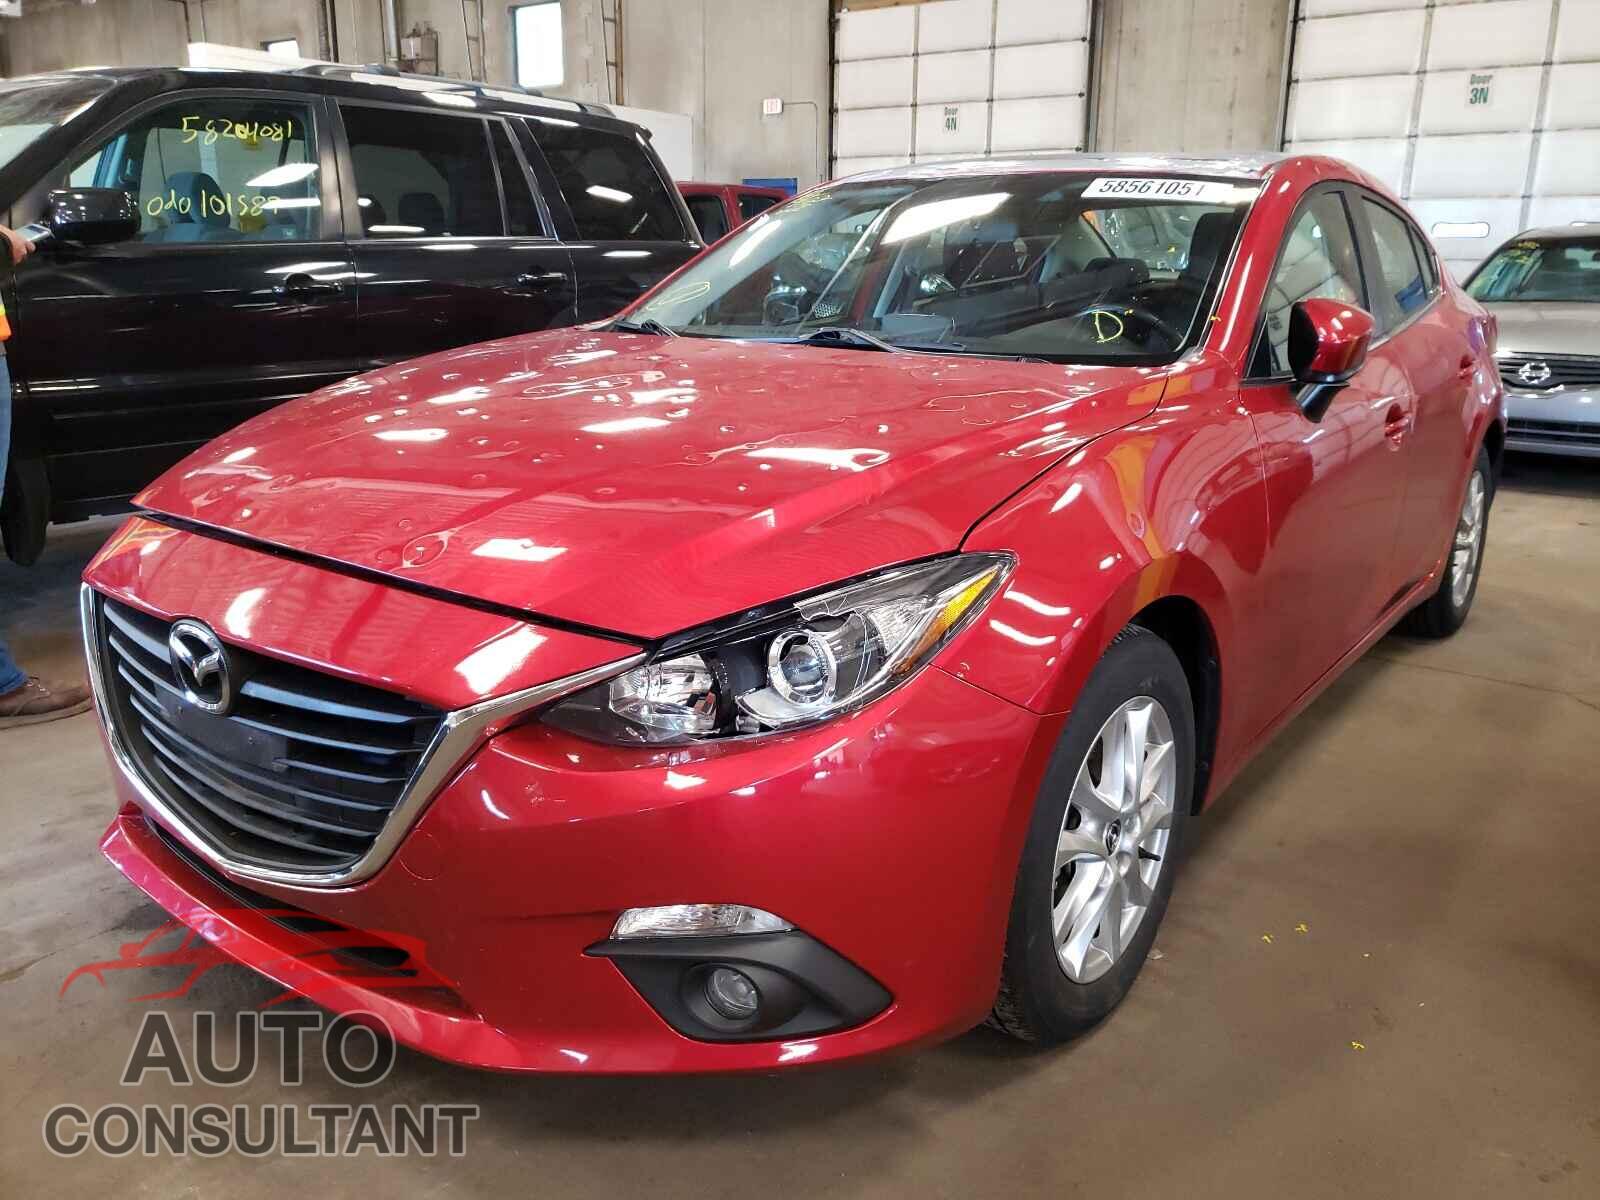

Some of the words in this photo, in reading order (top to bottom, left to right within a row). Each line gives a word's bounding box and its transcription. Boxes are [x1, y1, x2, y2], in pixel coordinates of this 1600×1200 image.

[1470, 86, 1489, 104] 3N
[944, 117, 957, 131] 4N
[1099, 180, 1205, 196] 58561051
